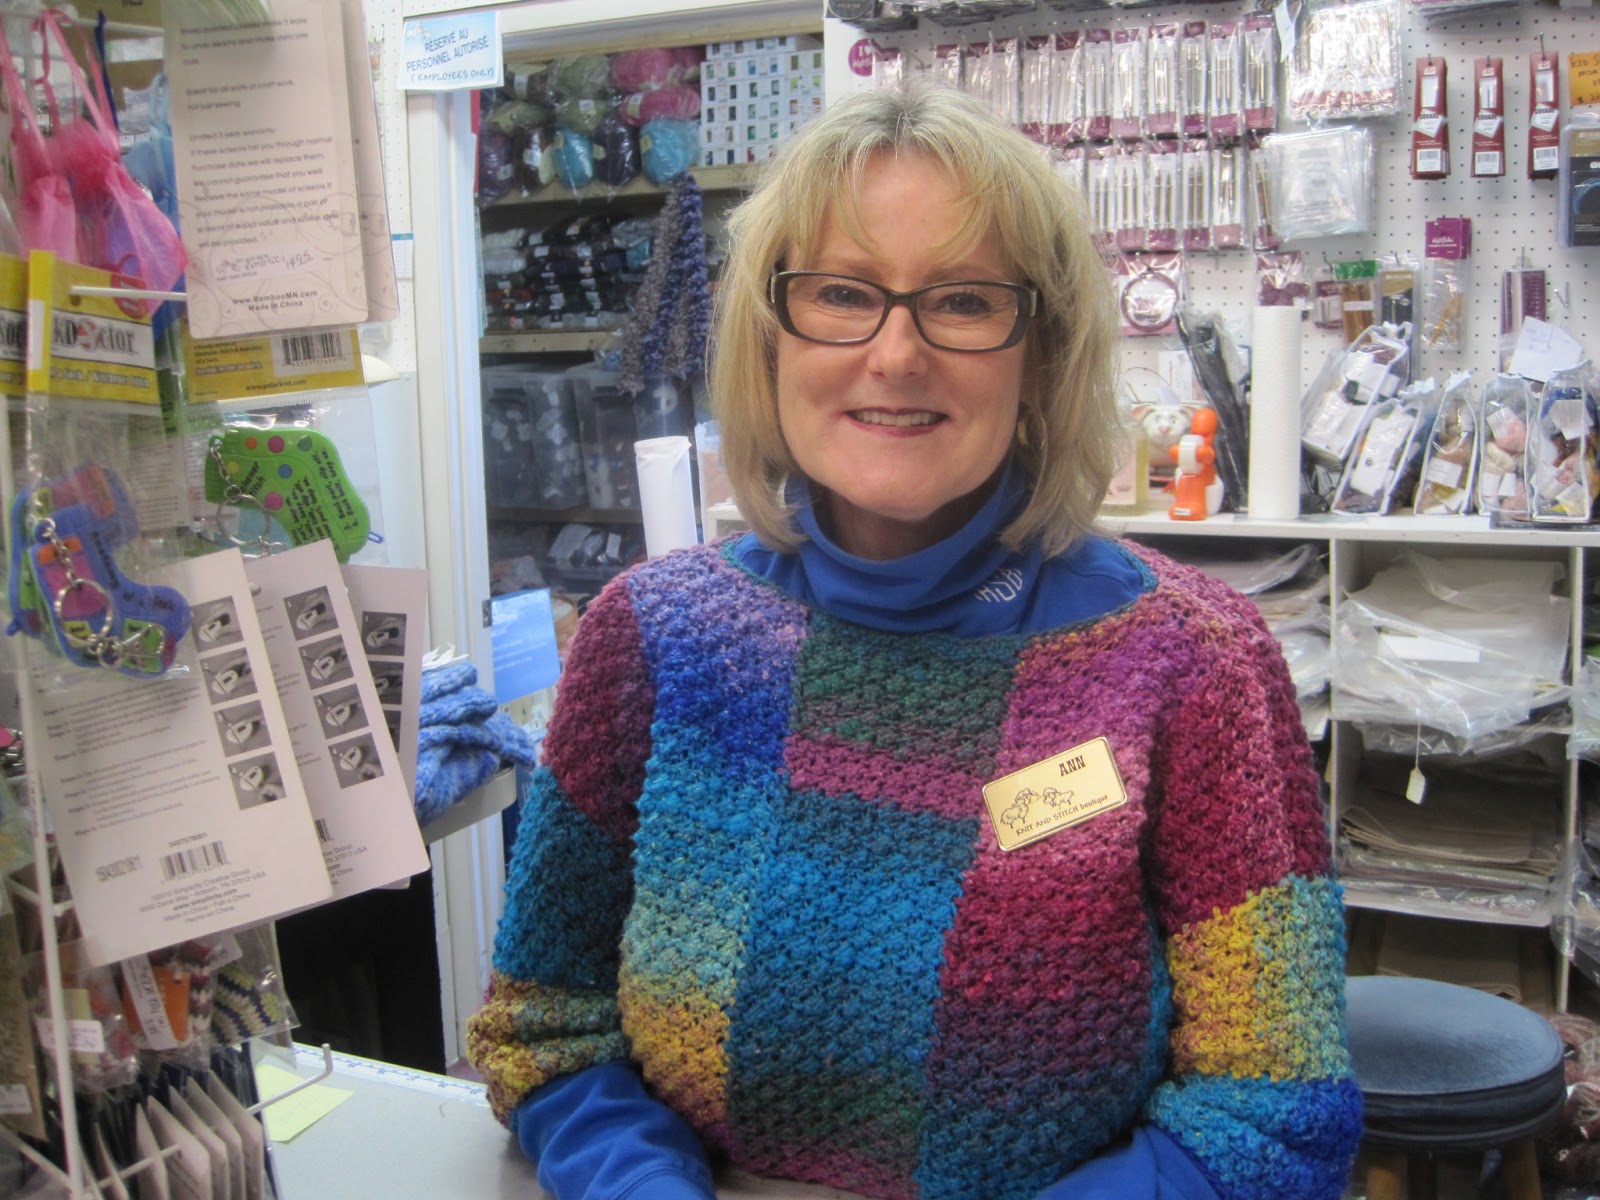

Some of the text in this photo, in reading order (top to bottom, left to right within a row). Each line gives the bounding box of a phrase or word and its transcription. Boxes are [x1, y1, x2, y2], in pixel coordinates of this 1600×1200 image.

[459, 28, 468, 40] AU
[406, 51, 451, 72] PERSONNEL
[280, 300, 303, 308] China
[1059, 755, 1086, 776] ANN
[1016, 795, 1108, 836] KNIT AND STITCH boutique
[353, 846, 368, 854] USA
[251, 870, 266, 879] USA
